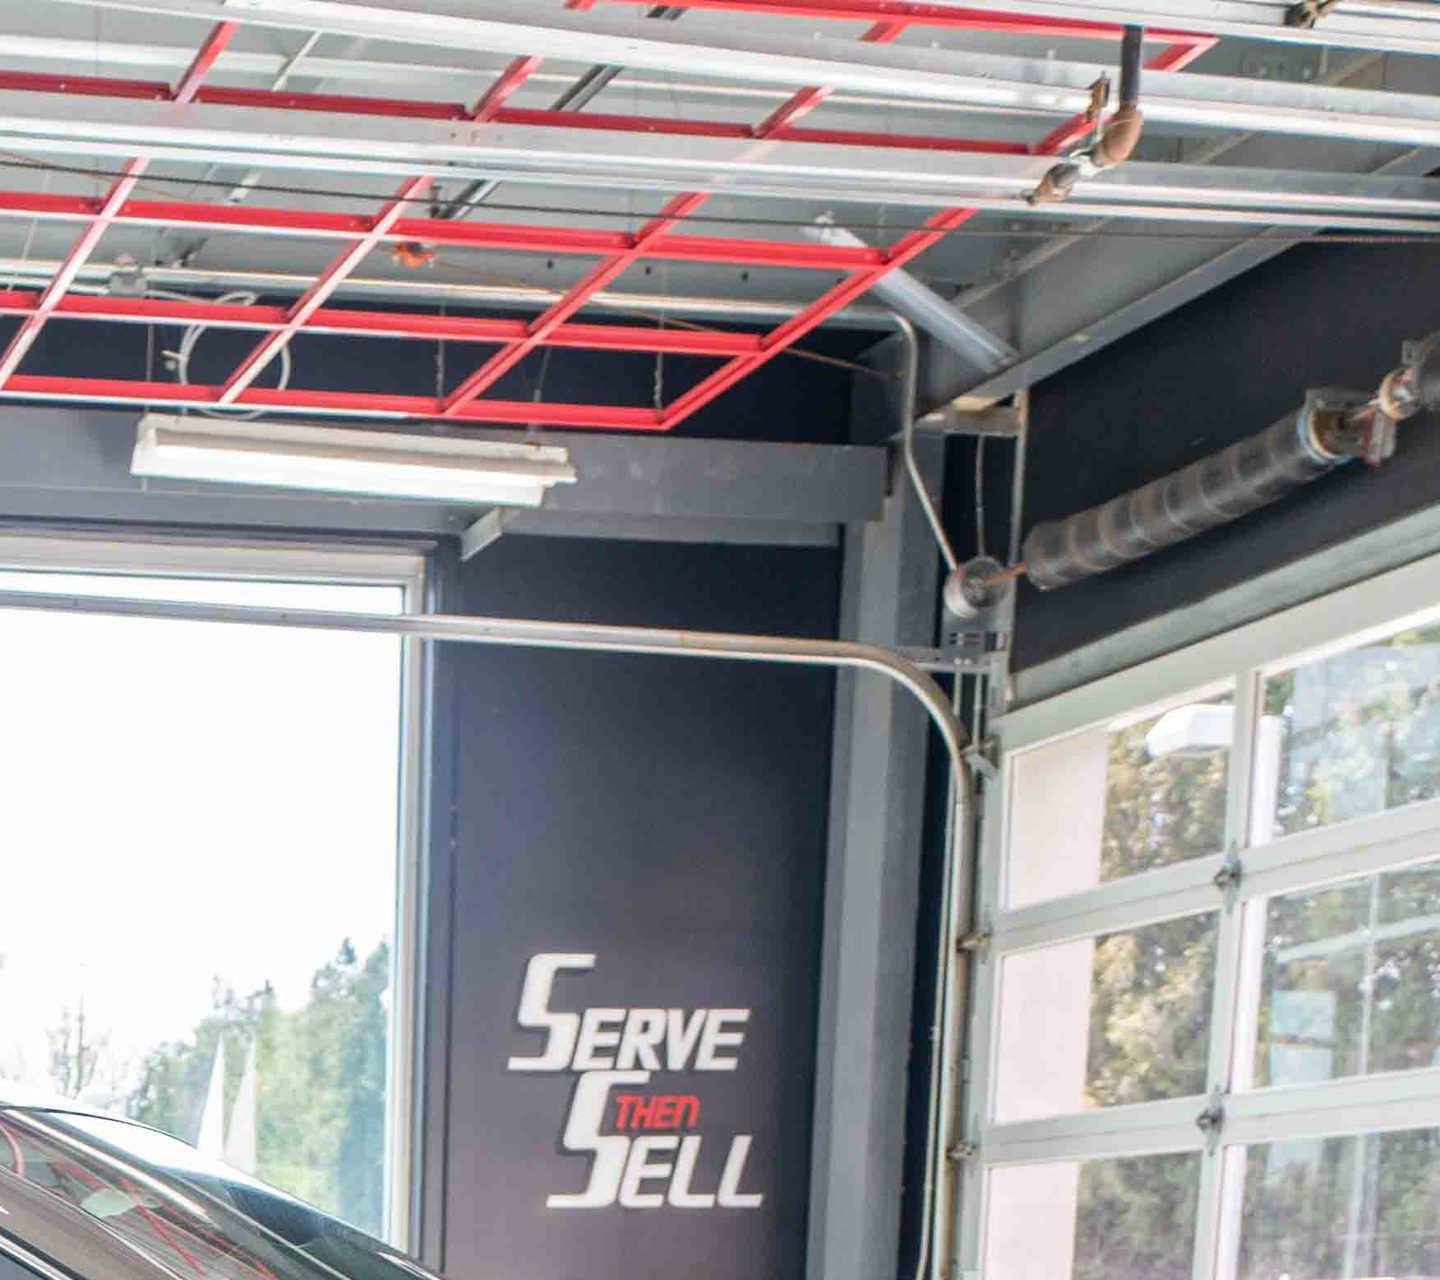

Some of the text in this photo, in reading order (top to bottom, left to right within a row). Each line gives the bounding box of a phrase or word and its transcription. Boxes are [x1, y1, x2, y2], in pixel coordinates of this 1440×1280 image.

[507, 953, 751, 1072] SERVE
[545, 1071, 765, 1209] SELL
[613, 1094, 702, 1130] THEN
